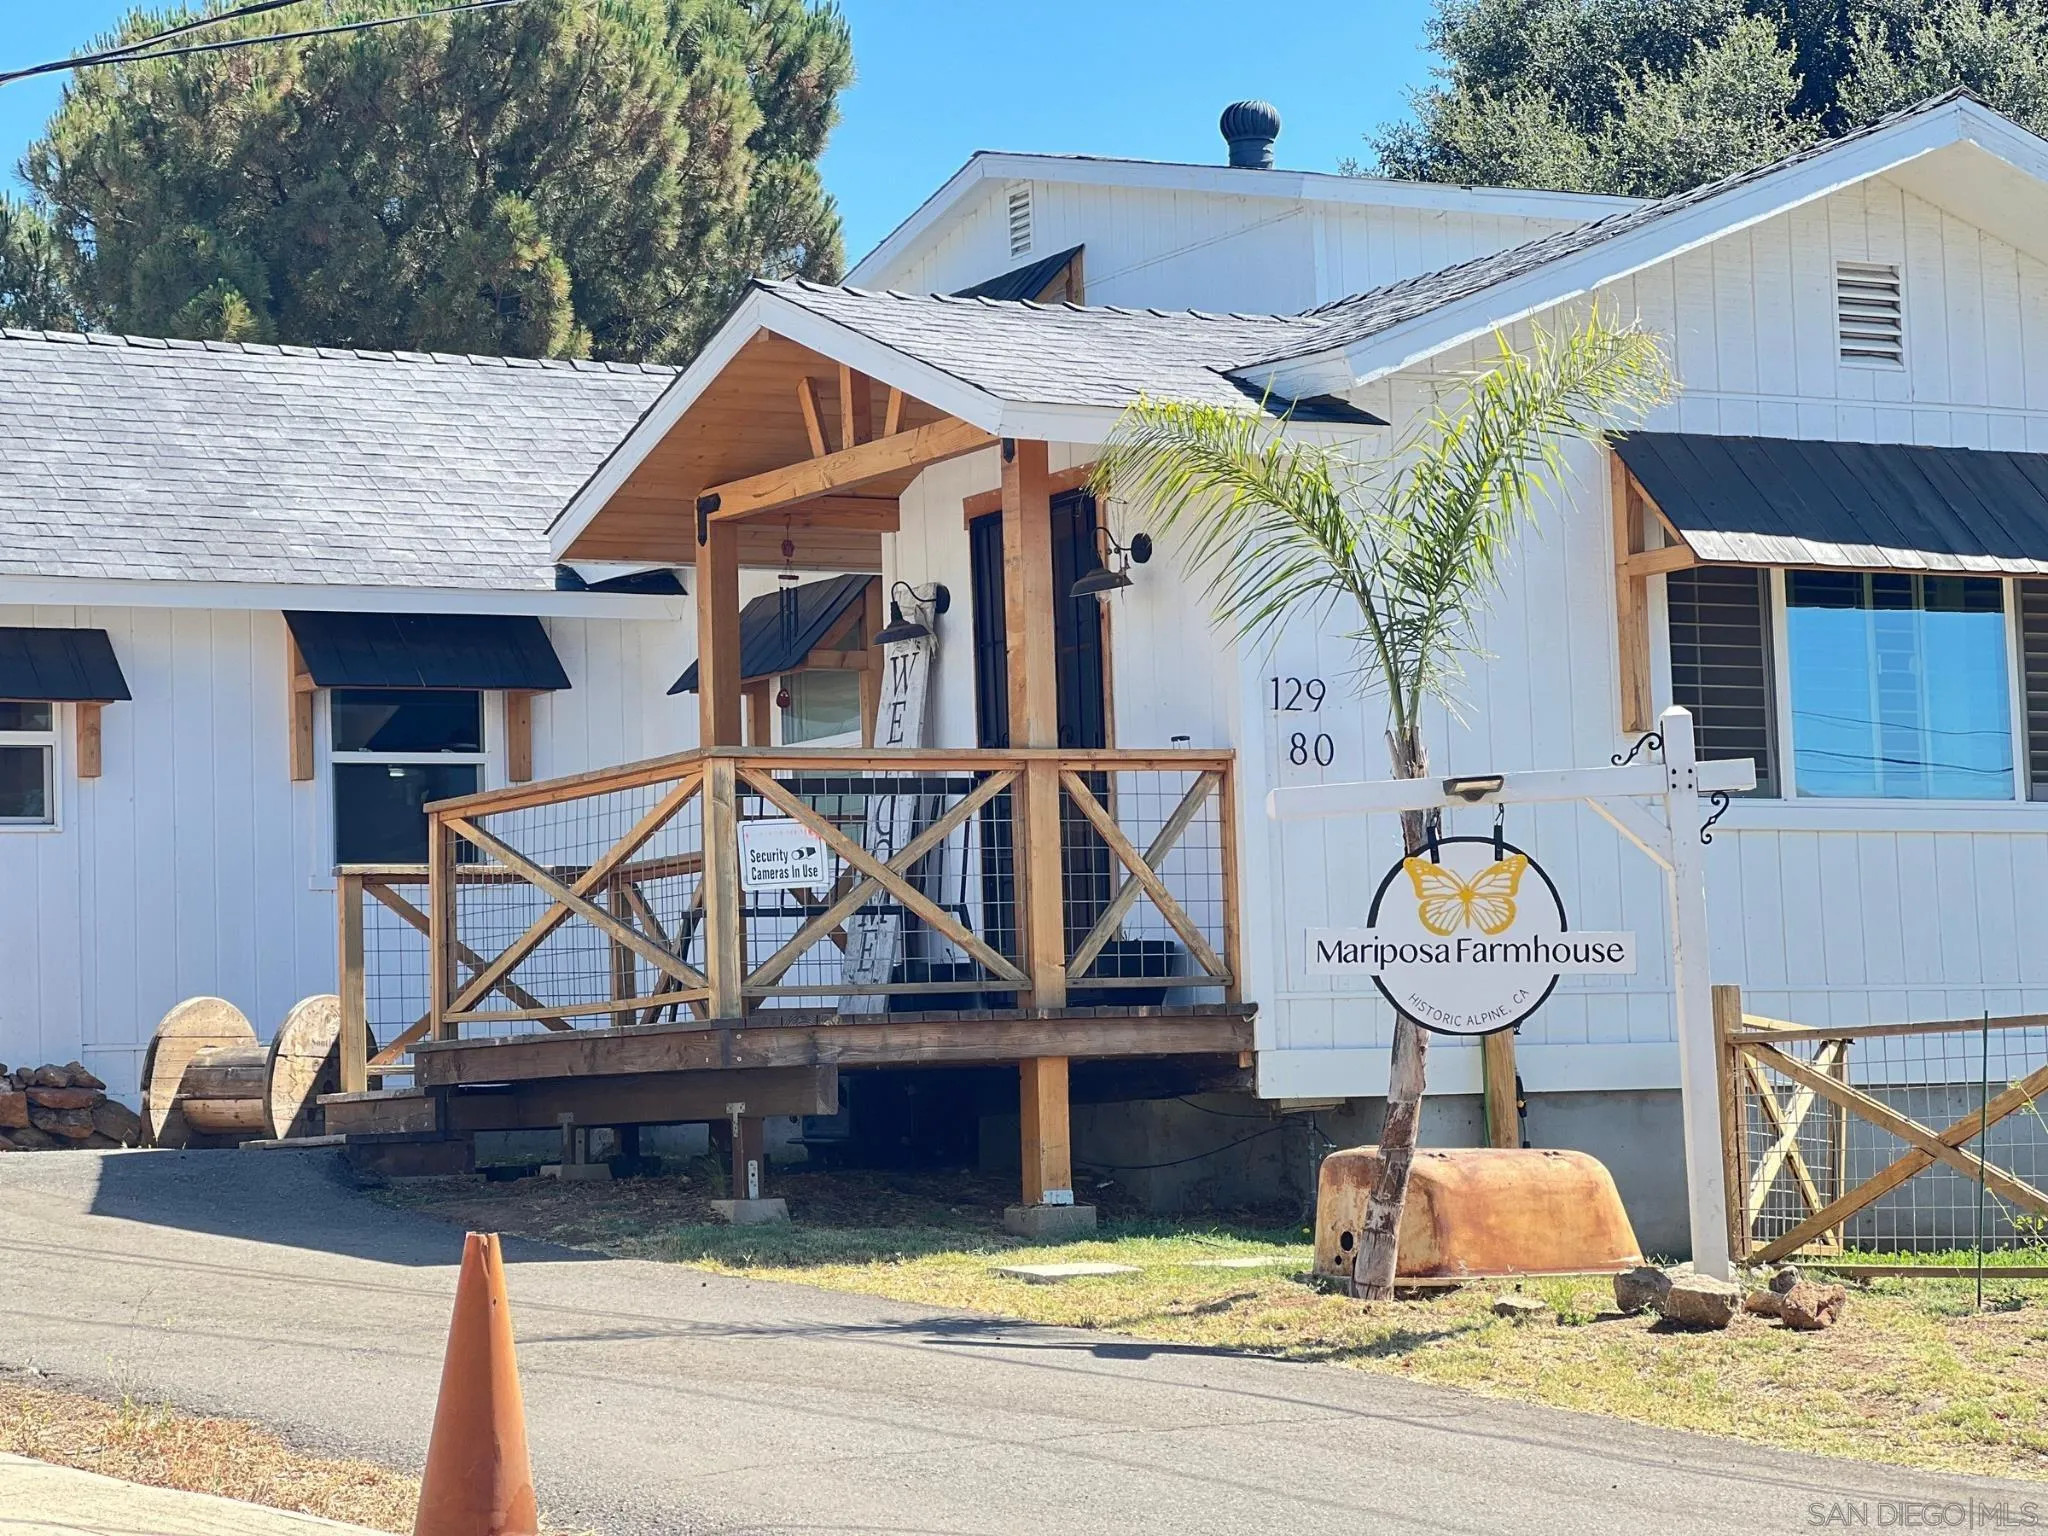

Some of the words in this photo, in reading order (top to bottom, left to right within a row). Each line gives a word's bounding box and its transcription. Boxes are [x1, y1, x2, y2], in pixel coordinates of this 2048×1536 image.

[1271, 677, 1326, 712] 129
[1290, 732, 1334, 766] 80
[857, 652, 919, 973] WECME
[750, 848, 788, 864] Security
[751, 866, 789, 880] Cameras
[792, 865, 799, 878] In
[803, 864, 818, 877] Use
[1317, 936, 1450, 970] Mariposa
[1456, 935, 1625, 964] Farmhouse
[1408, 993, 1461, 1026] HISTORIC
[1513, 989, 1529, 1004] CA
